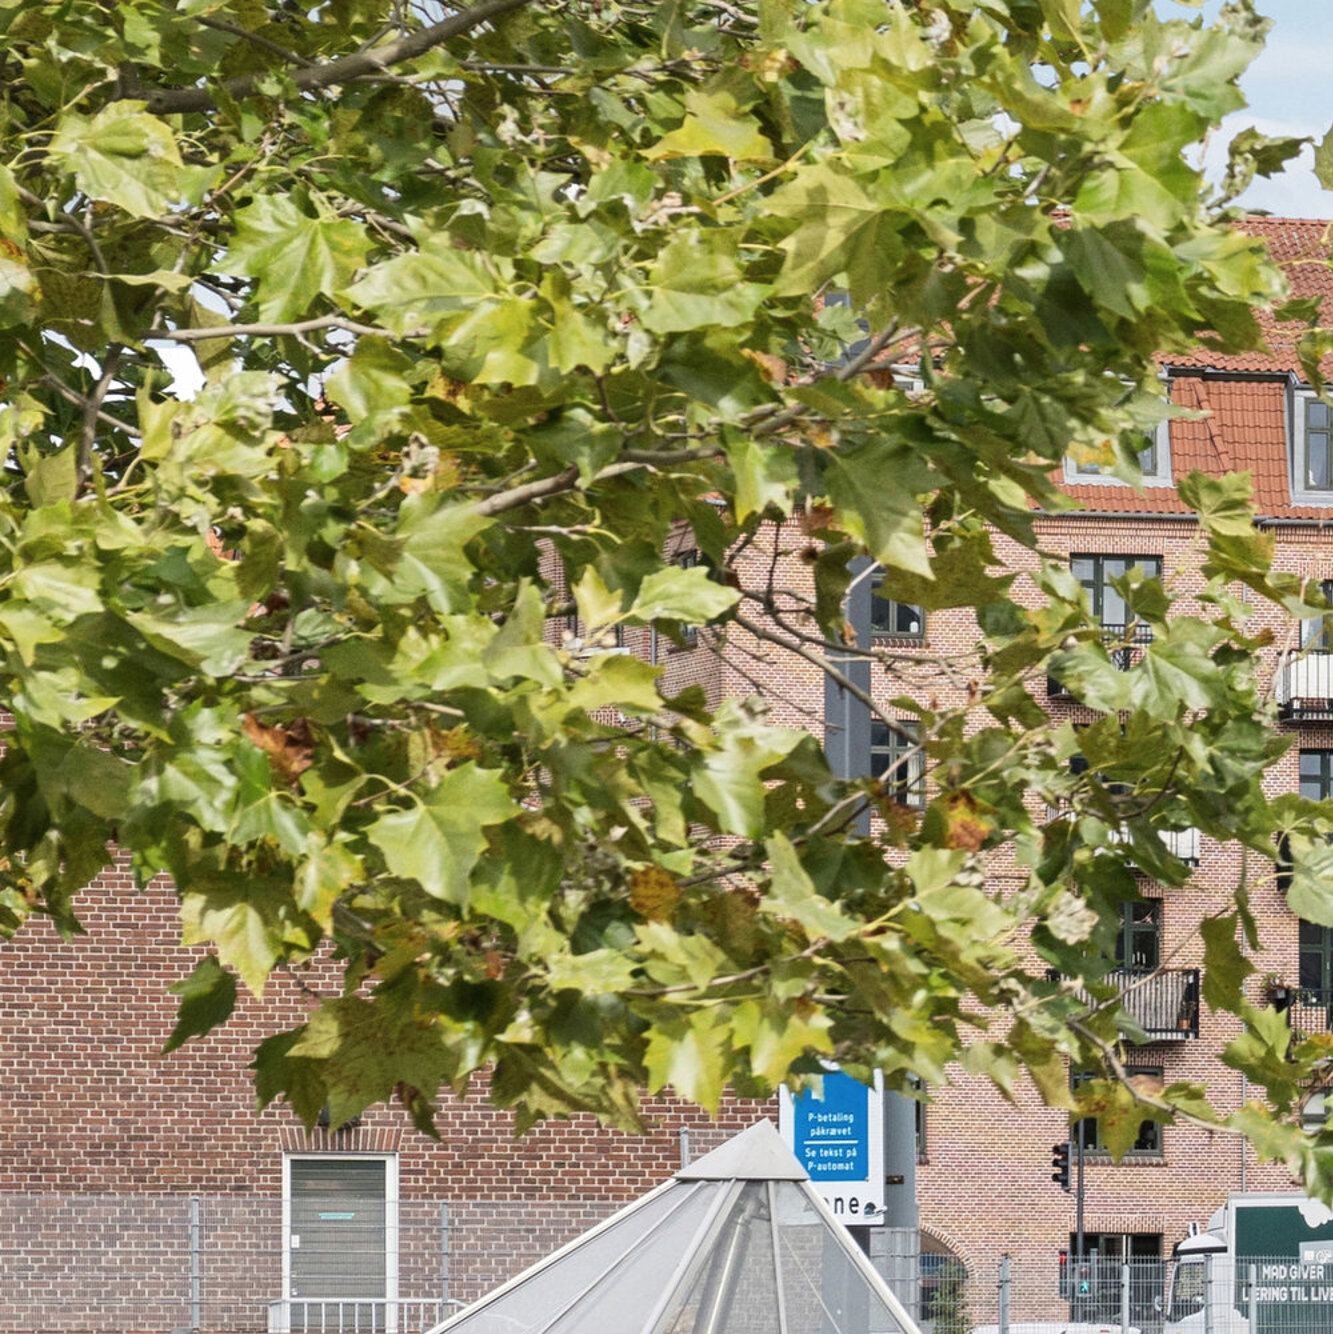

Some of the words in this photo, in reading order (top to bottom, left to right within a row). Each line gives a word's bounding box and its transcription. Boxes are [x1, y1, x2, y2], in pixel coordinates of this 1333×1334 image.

[808, 1113, 854, 1123] P-betaling
[810, 1127, 852, 1136] påkrævet
[805, 1148, 816, 1157] Se
[820, 1148, 843, 1157] tekst
[846, 1147, 857, 1158] på
[807, 1161, 854, 1171] P-automat
[1262, 1266, 1287, 1279] MAD
[1290, 1266, 1325, 1280] GIVER
[1290, 1286, 1308, 1301] TIL
